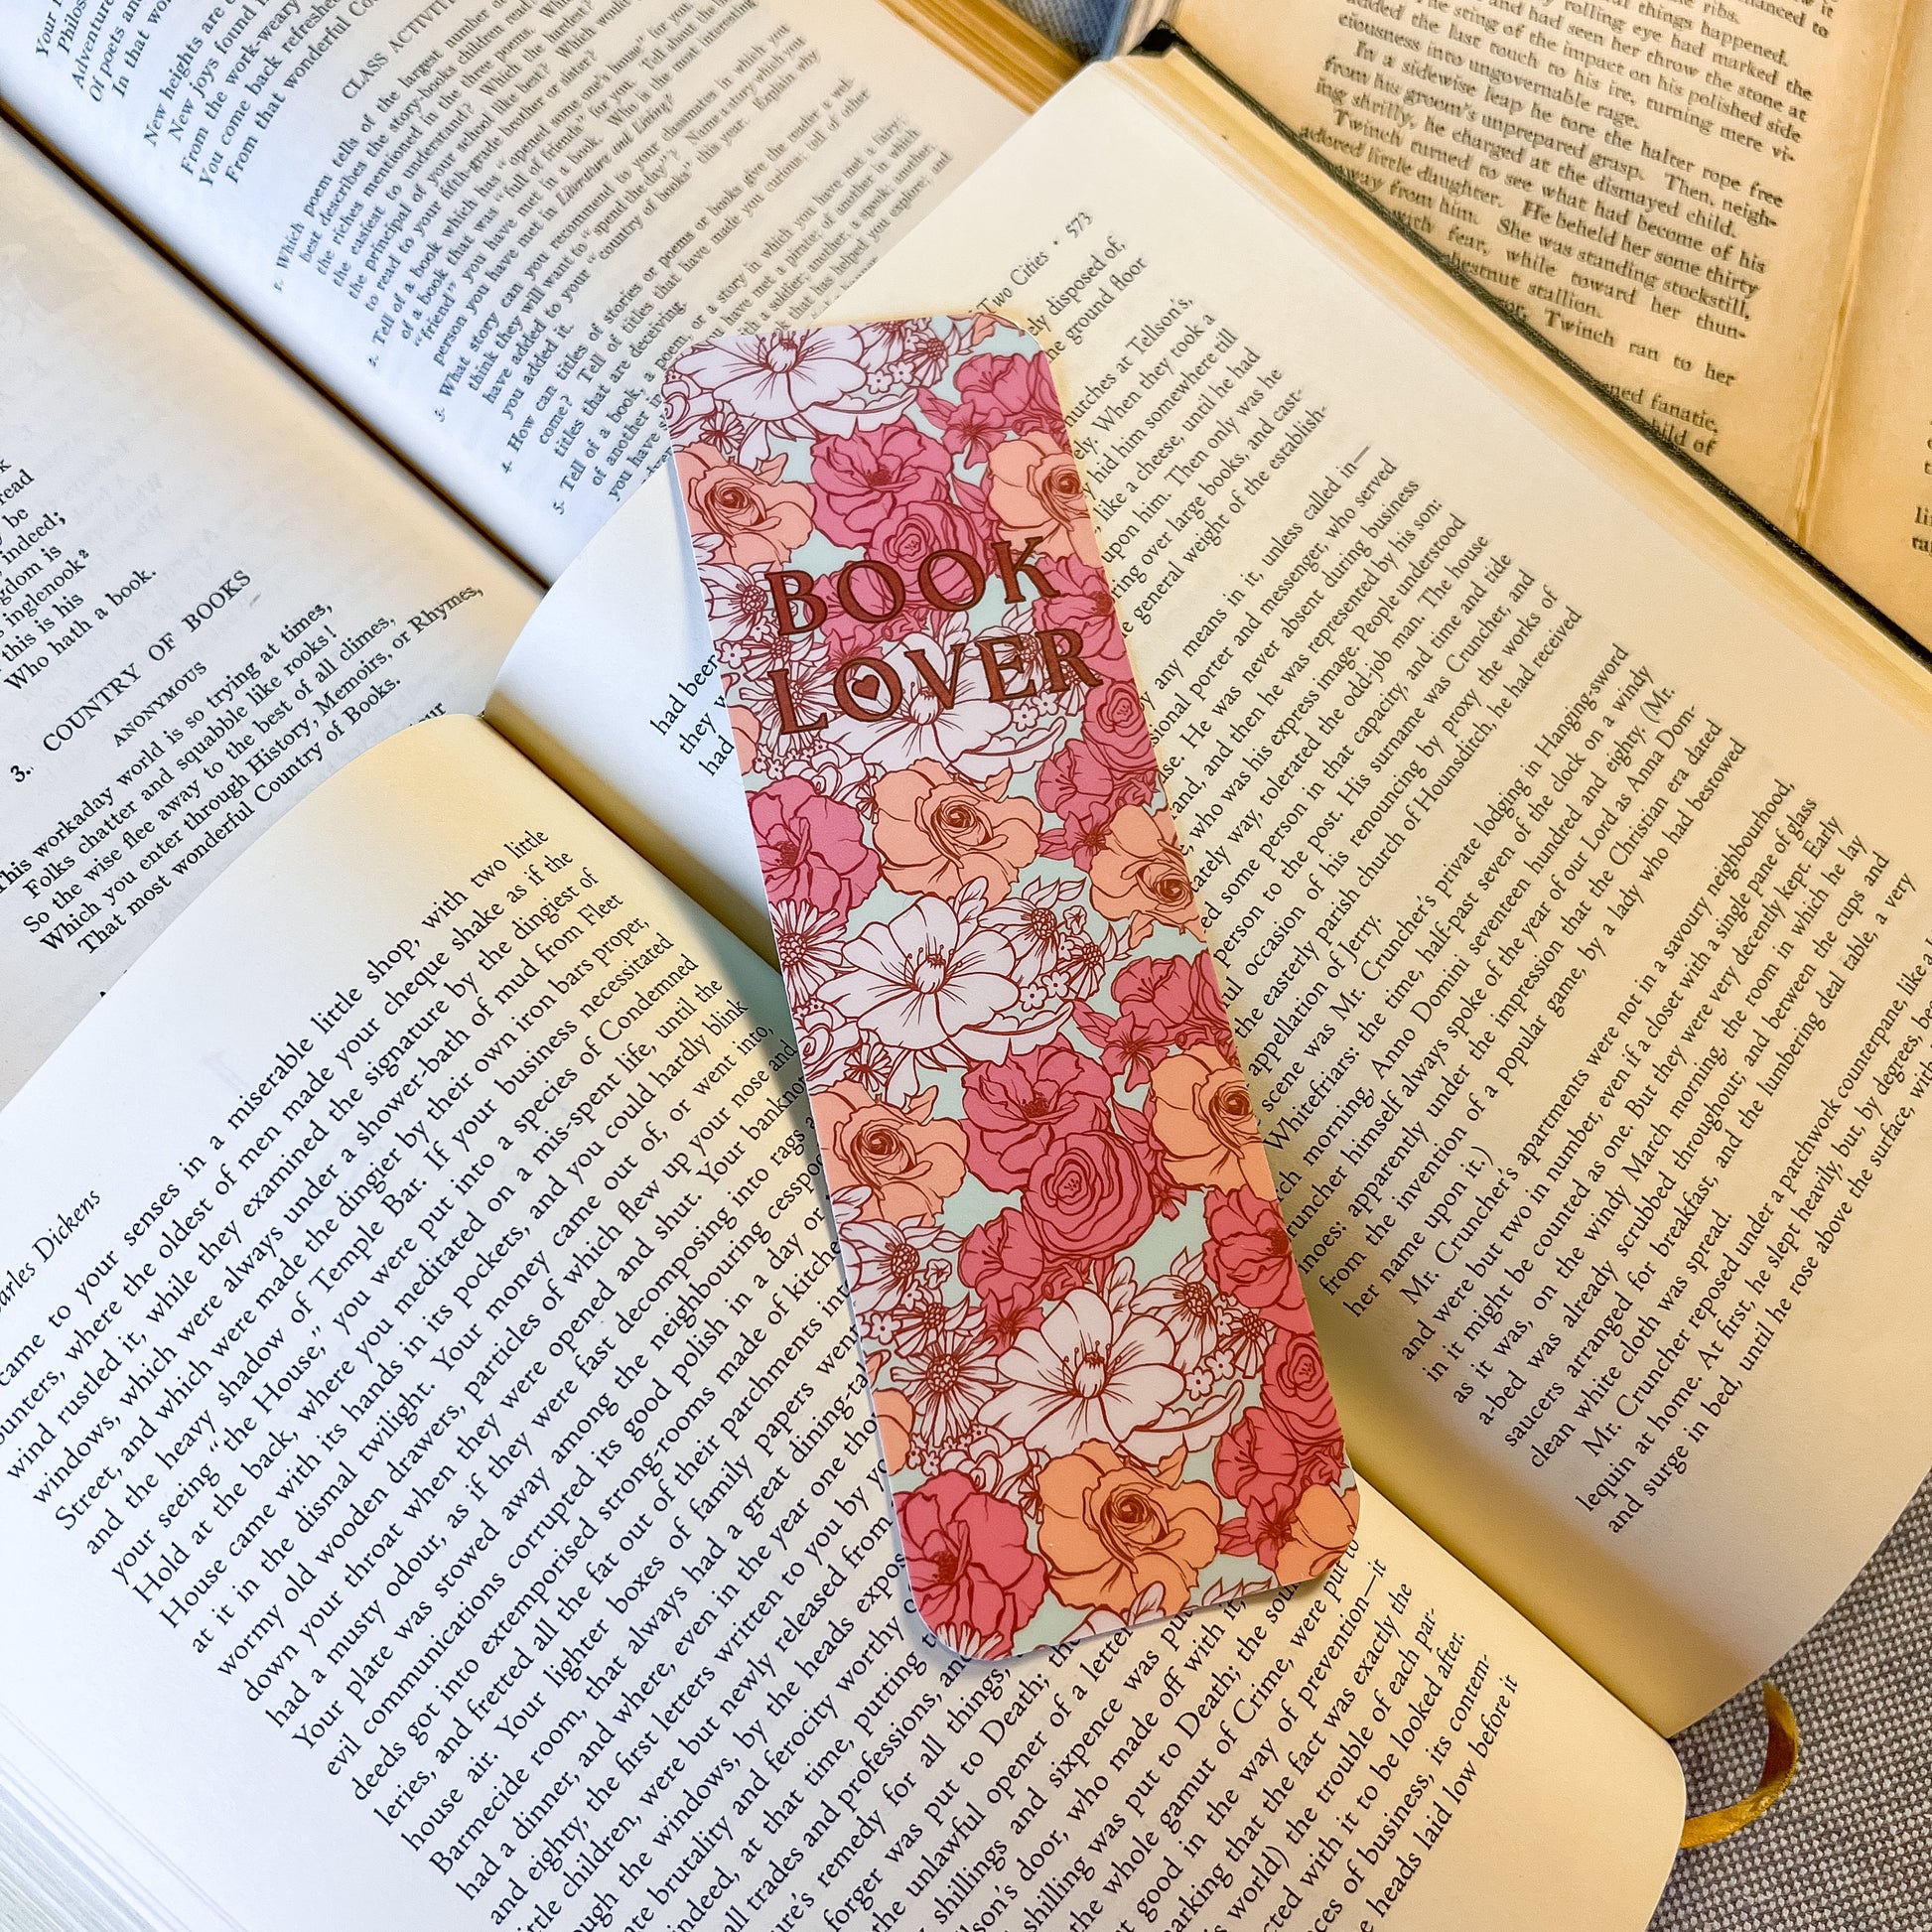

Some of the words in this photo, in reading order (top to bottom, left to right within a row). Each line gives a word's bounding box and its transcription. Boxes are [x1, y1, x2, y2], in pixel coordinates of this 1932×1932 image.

[143, 102, 167, 147] New
[159, 37, 204, 100] heights
[202, 6, 225, 34] are
[224, 135, 258, 184] From
[253, 92, 286, 130] that
[283, 15, 351, 89] wonderful
[275, 222, 305, 269] Which
[303, 175, 334, 218] poem
[332, 137, 360, 168] tells
[360, 113, 376, 133] of
[374, 91, 401, 113] the
[396, 49, 444, 88] largest
[444, 9, 490, 49] number
[342, 53, 392, 100] CLASS
[1354, 39, 1377, 63] In
[1381, 55, 1396, 69] a
[1401, 59, 1477, 97] sidewise
[1483, 83, 1524, 116] leap
[1530, 100, 1553, 124] he
[1560, 113, 1596, 139] tore
[1603, 127, 1634, 152] the
[1640, 138, 1696, 173] halter
[1702, 166, 1743, 193] rope
[1748, 180, 1784, 208] free
[506, 414, 535, 453] How
[535, 385, 558, 412] can
[554, 345, 588, 380] titles
[588, 322, 605, 342] of
[603, 283, 643, 325] stories
[642, 266, 658, 282] or
[657, 231, 696, 269] poems
[976, 287, 1014, 315] Two
[1010, 251, 1049, 286] Cities
[1064, 211, 1093, 239] 573
[1045, 254, 1108, 316] disposed
[1104, 235, 1126, 259] of,
[1496, 217, 1532, 244] She
[1538, 234, 1574, 258] was
[1576, 250, 1661, 292] standing
[1662, 279, 1750, 323] stockstill,
[1544, 307, 1615, 348] Twinch
[1628, 342, 1659, 362] ran
[1673, 353, 1693, 372] to
[1704, 360, 1737, 387] her
[1100, 492, 1129, 522] like
[1125, 482, 1140, 493] a
[1135, 435, 1185, 482] cheese,
[1181, 393, 1217, 432] until
[1207, 378, 1234, 399] he
[1225, 345, 1261, 379] had
[1650, 392, 1719, 435] fanatic,
[764, 536, 1060, 636] BOOK
[1133, 560, 1185, 625] general
[1181, 513, 1230, 563] weight
[1228, 488, 1247, 514] of
[1243, 471, 1270, 495] the
[1269, 406, 1325, 470] establish-
[3, 656, 50, 690] Who
[46, 620, 93, 656] hath
[93, 608, 109, 621] a
[104, 570, 157, 607] book.
[43, 662, 142, 752] COUNTRY
[148, 631, 176, 661] OF
[181, 569, 251, 633] BOOKS
[113, 661, 207, 748] ANONYMOUS
[766, 627, 1103, 736] LOVER
[10, 764, 35, 783] 3.
[22, 855, 75, 899] Folks
[77, 800, 138, 855] chatter
[140, 766, 176, 801] and
[176, 706, 248, 771] squabble
[245, 676, 282, 707] like
[283, 624, 338, 677] rooks!
[39, 902, 102, 950] Which
[101, 871, 139, 906] you
[139, 829, 184, 871] enter
[183, 773, 251, 831] through
[244, 717, 320, 776] History,
[312, 652, 393, 717] Memoirs,
[392, 630, 412, 649] or
[406, 587, 484, 634] Rhymes,
[76, 913, 127, 954] That
[126, 875, 172, 916] most
[171, 800, 256, 876] wonderful
[254, 742, 323, 802] Country
[326, 719, 345, 743] of
[341, 678, 401, 726] Books.
[0, 1334, 46, 1387] came
[48, 1305, 71, 1328] to
[74, 1250, 119, 1306] your
[123, 1183, 181, 1247] senses
[179, 1156, 207, 1179] in
[209, 1135, 225, 1151] a
[227, 1038, 314, 1131] miserable
[310, 988, 363, 1035] little
[366, 938, 420, 985] shop,
[421, 890, 470, 929] with
[470, 859, 507, 889] two
[502, 829, 549, 860] little
[1398, 1270, 1441, 1307] Mr.
[1435, 1167, 1519, 1264] Cruncher's
[1517, 1068, 1590, 1167] apartments
[1586, 1026, 1619, 1066] were
[1616, 993, 1643, 1026] not
[1634, 974, 1658, 995] in
[1654, 960, 1668, 974] a
[1663, 896, 1713, 960] savoury
[1706, 778, 1796, 897] neighbourhood,
[0, 1262, 36, 1312] arles
[31, 1190, 100, 1264] Dickens
[1530, 1423, 1577, 1468] clean
[1573, 1366, 1622, 1419] white
[1619, 1315, 1662, 1364] cloth
[1656, 1276, 1689, 1311] was
[1685, 1208, 1732, 1275] spread.
[1607, 1492, 1645, 1534] and
[1643, 1445, 1689, 1497] surge
[1683, 1421, 1710, 1444] in
[1700, 1374, 1743, 1418] bed,
[1738, 1319, 1775, 1371] until
[1764, 1298, 1792, 1325] he
[1789, 1256, 1819, 1297] rose
[1814, 1201, 1853, 1255] above
[1847, 1169, 1873, 1199] the
[1869, 1106, 1916, 1168] surface,
[490, 1876, 529, 1926] and
[528, 1815, 589, 1881] eighty,
[586, 1776, 621, 1812] the
[615, 1730, 659, 1776] first
[650, 1666, 716, 1732] letters
[713, 1589, 784, 1663] written
[781, 1562, 805, 1587] to
[803, 1518, 844, 1567] you
[834, 1485, 870, 1517] by
[1255, 1776, 1295, 1817] the
[1287, 1729, 1327, 1776] fact
[1322, 1687, 1356, 1728] was
[1353, 1614, 1402, 1686] exactly
[1387, 1584, 1413, 1615] the
[1299, 1837, 1344, 1886] with
[1335, 1811, 1360, 1836] it
[1356, 1785, 1378, 1811] to
[1369, 1753, 1400, 1782] be
[1389, 1673, 1444, 1752] looked
[1436, 1631, 1465, 1680] after.
[1365, 1852, 1422, 1918] heads
[1412, 1800, 1453, 1852] laid
[1442, 1759, 1477, 1805] low
[1467, 1695, 1511, 1759] before
[1499, 1674, 1518, 1695] it
